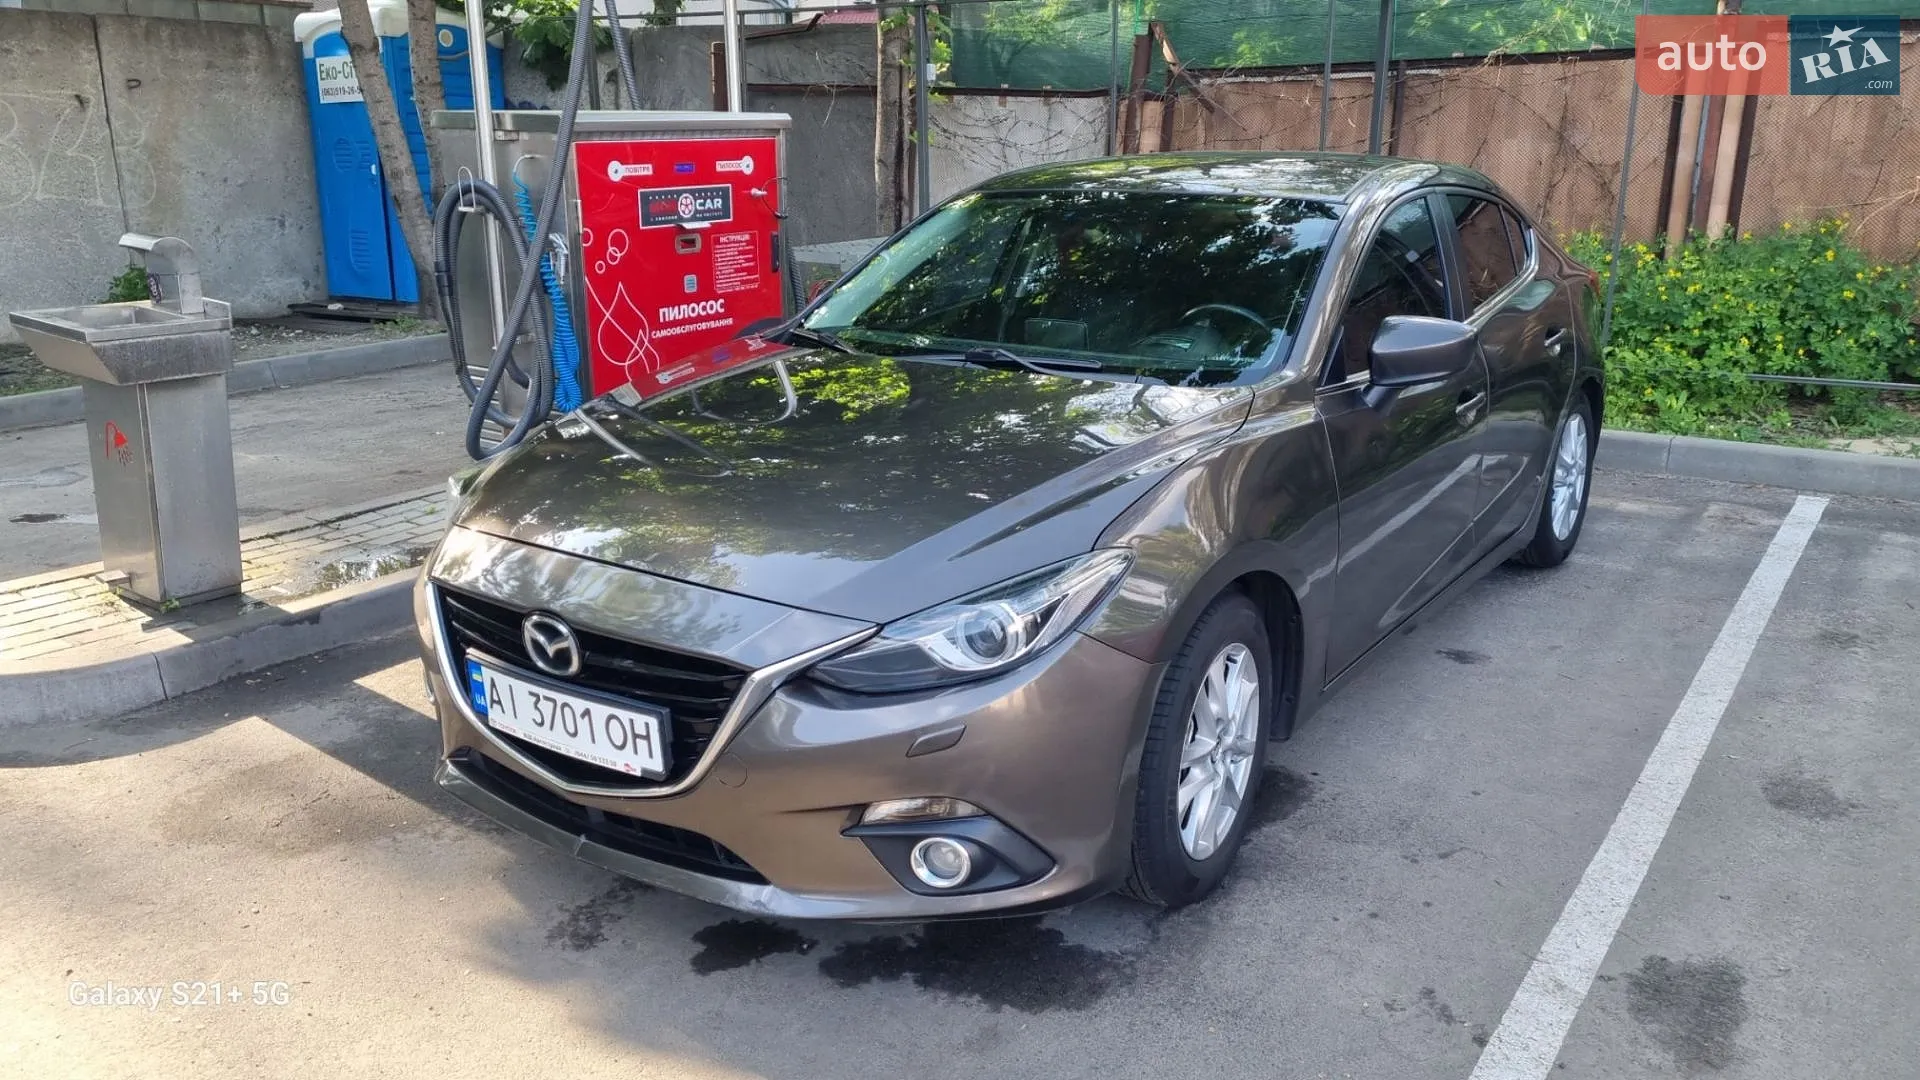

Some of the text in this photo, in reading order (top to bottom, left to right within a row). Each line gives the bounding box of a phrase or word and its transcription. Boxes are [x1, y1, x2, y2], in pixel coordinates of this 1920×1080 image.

[319, 61, 353, 81] Еко-Сі
[696, 198, 722, 210] CAR
[659, 299, 725, 323] ПИЛОСОС
[651, 318, 734, 339] САМООБСЛУГОВУВАННЯ
[475, 692, 487, 707] UA
[490, 676, 518, 720] AI
[528, 690, 597, 745] 3701
[605, 713, 654, 760] OH
